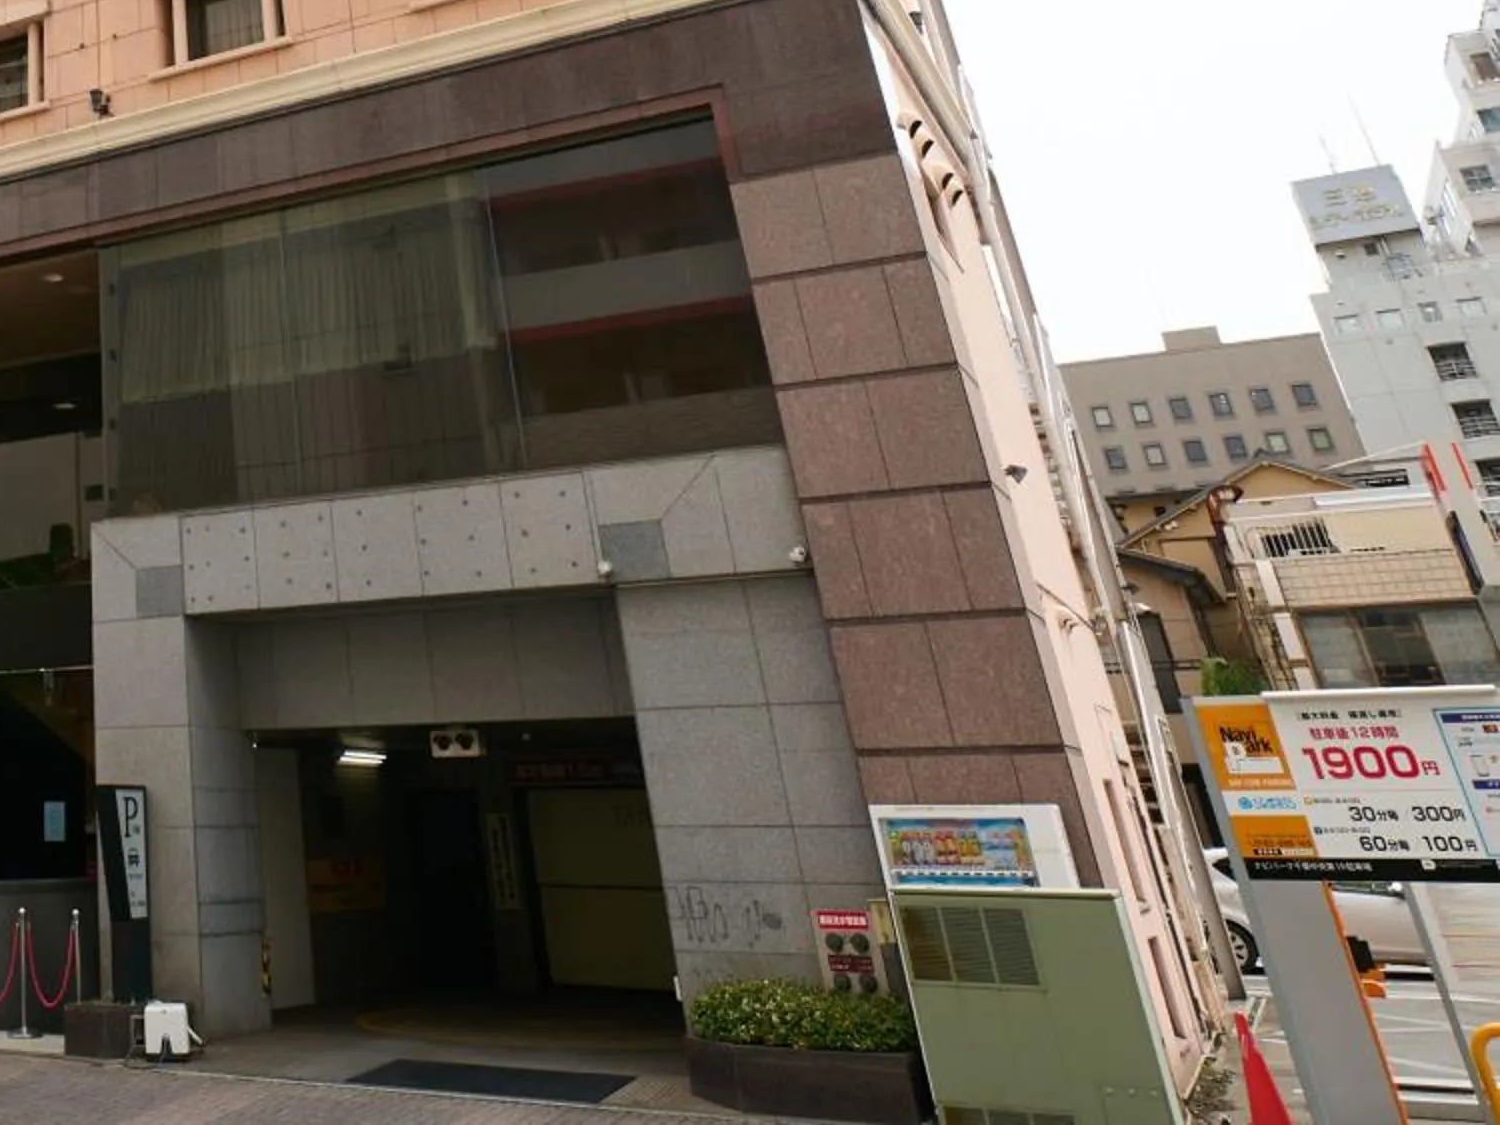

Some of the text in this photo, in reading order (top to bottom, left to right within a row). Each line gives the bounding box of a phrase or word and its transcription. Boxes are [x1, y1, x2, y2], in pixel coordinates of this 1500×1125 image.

[1219, 725, 1257, 745] Navi
[1301, 745, 1440, 779] 1900円
[123, 796, 139, 838] P
